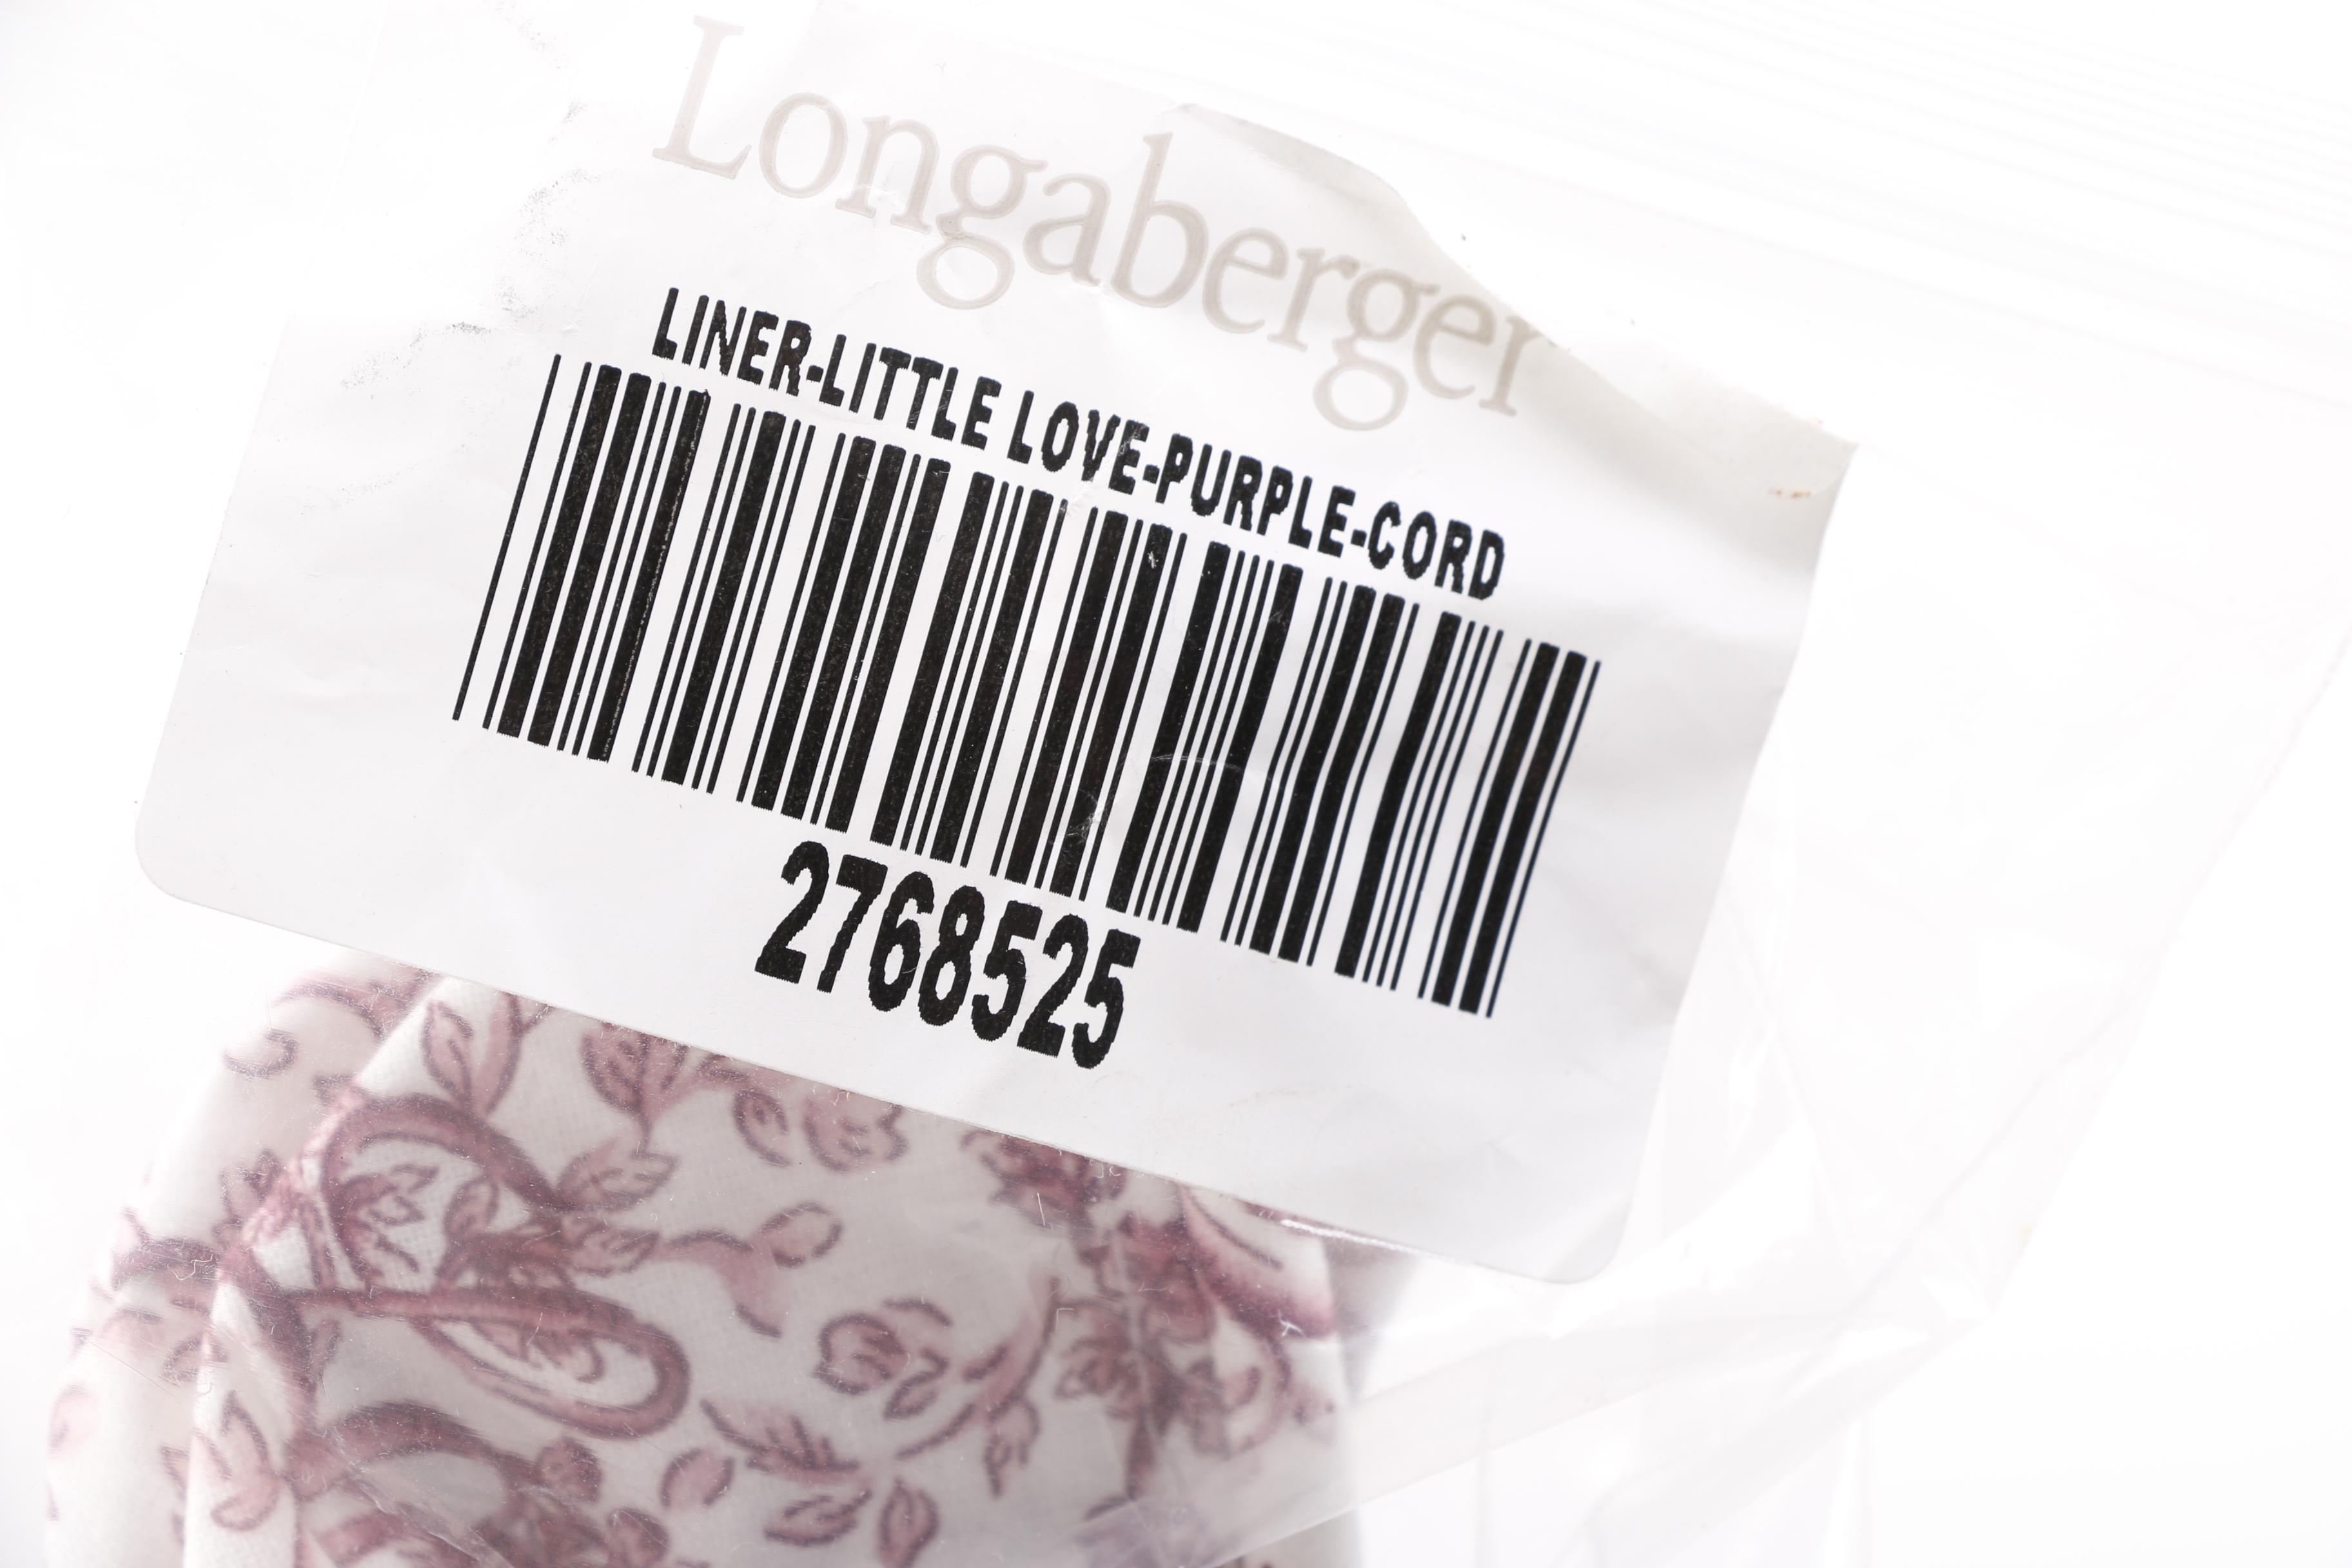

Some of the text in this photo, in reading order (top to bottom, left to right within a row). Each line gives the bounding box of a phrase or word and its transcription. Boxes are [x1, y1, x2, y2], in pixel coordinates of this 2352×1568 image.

[652, 14, 1555, 431] Longaberger
[652, 288, 1504, 600] LINER-LITTLE LOVE-PURPLE-CORD
[754, 841, 1141, 1069] 2768525
